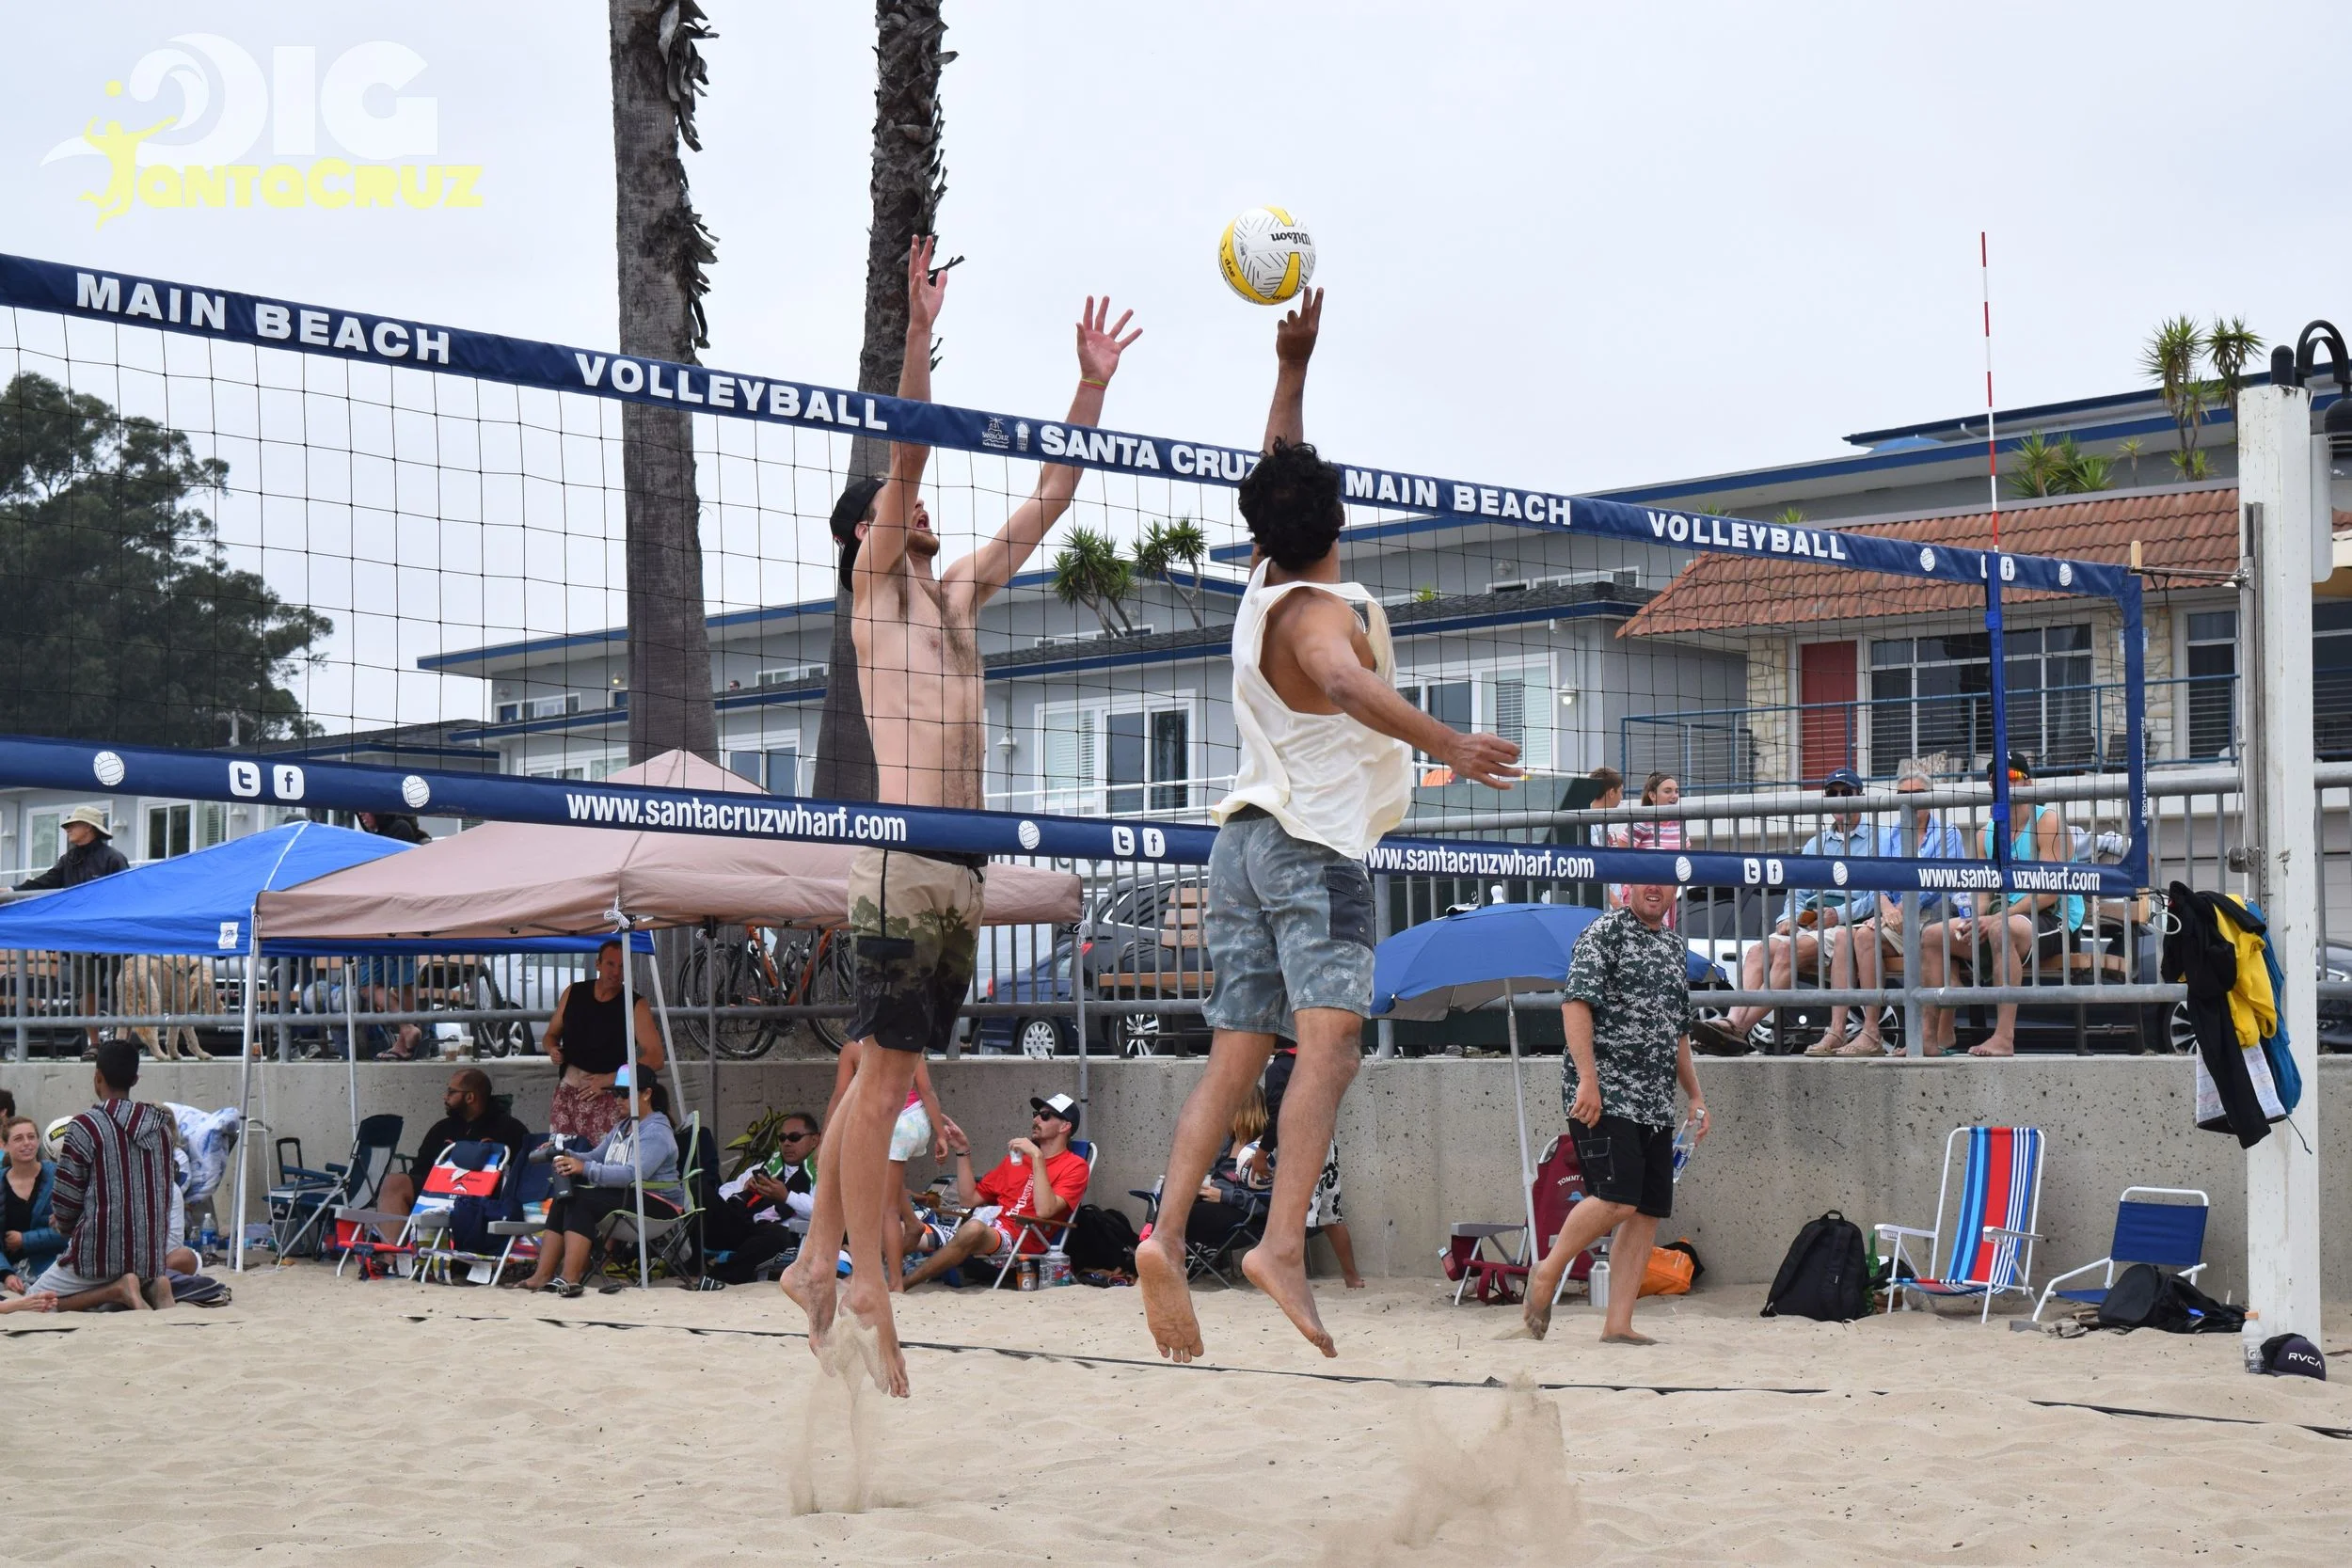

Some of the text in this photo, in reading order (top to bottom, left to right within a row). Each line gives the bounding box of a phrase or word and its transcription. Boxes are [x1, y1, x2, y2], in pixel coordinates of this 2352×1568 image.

[1270, 231, 1311, 245] Wilson
[76, 273, 888, 431] MAIN BEACH VOLLEYBALL
[1041, 425, 1160, 469] SANTA
[1345, 469, 1438, 508] MAIN
[1454, 485, 1571, 526] BEACH
[1647, 512, 1846, 561] VOLLEYBALL
[566, 794, 907, 842] www.santacruzwharf.com
[1557, 1175, 1581, 1186] TOMMY
[2288, 1353, 2322, 1370] RVCA
